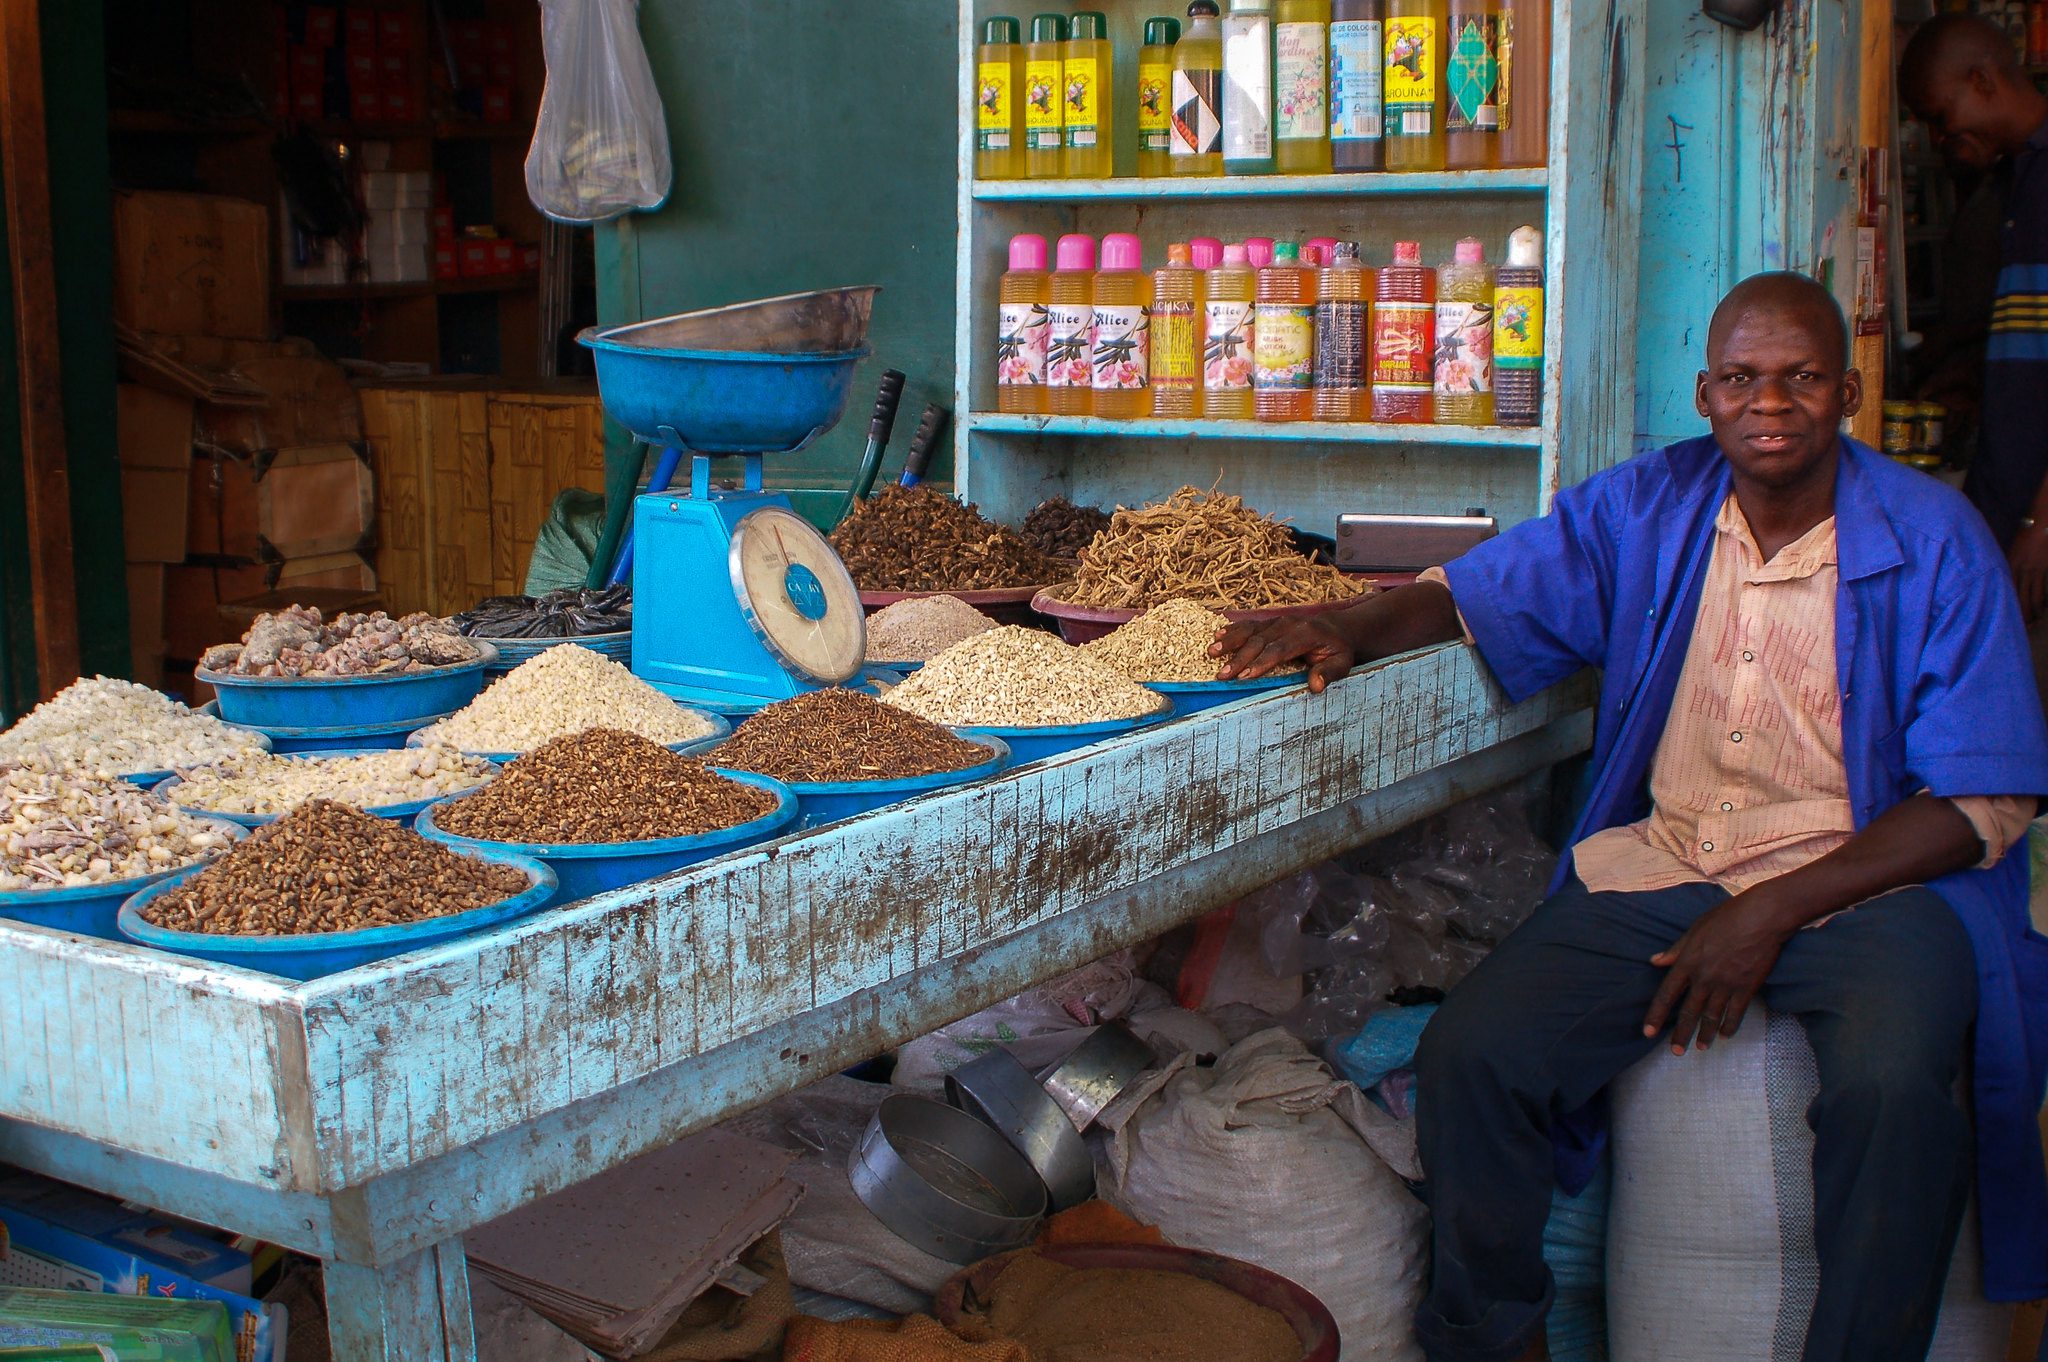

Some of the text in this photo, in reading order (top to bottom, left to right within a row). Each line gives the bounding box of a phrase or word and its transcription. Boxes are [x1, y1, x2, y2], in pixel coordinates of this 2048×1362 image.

[1213, 305, 1241, 317] Alice
[1438, 306, 1464, 318] Alice
[1049, 311, 1080, 325] Alice
[1095, 311, 1129, 327] Alice
